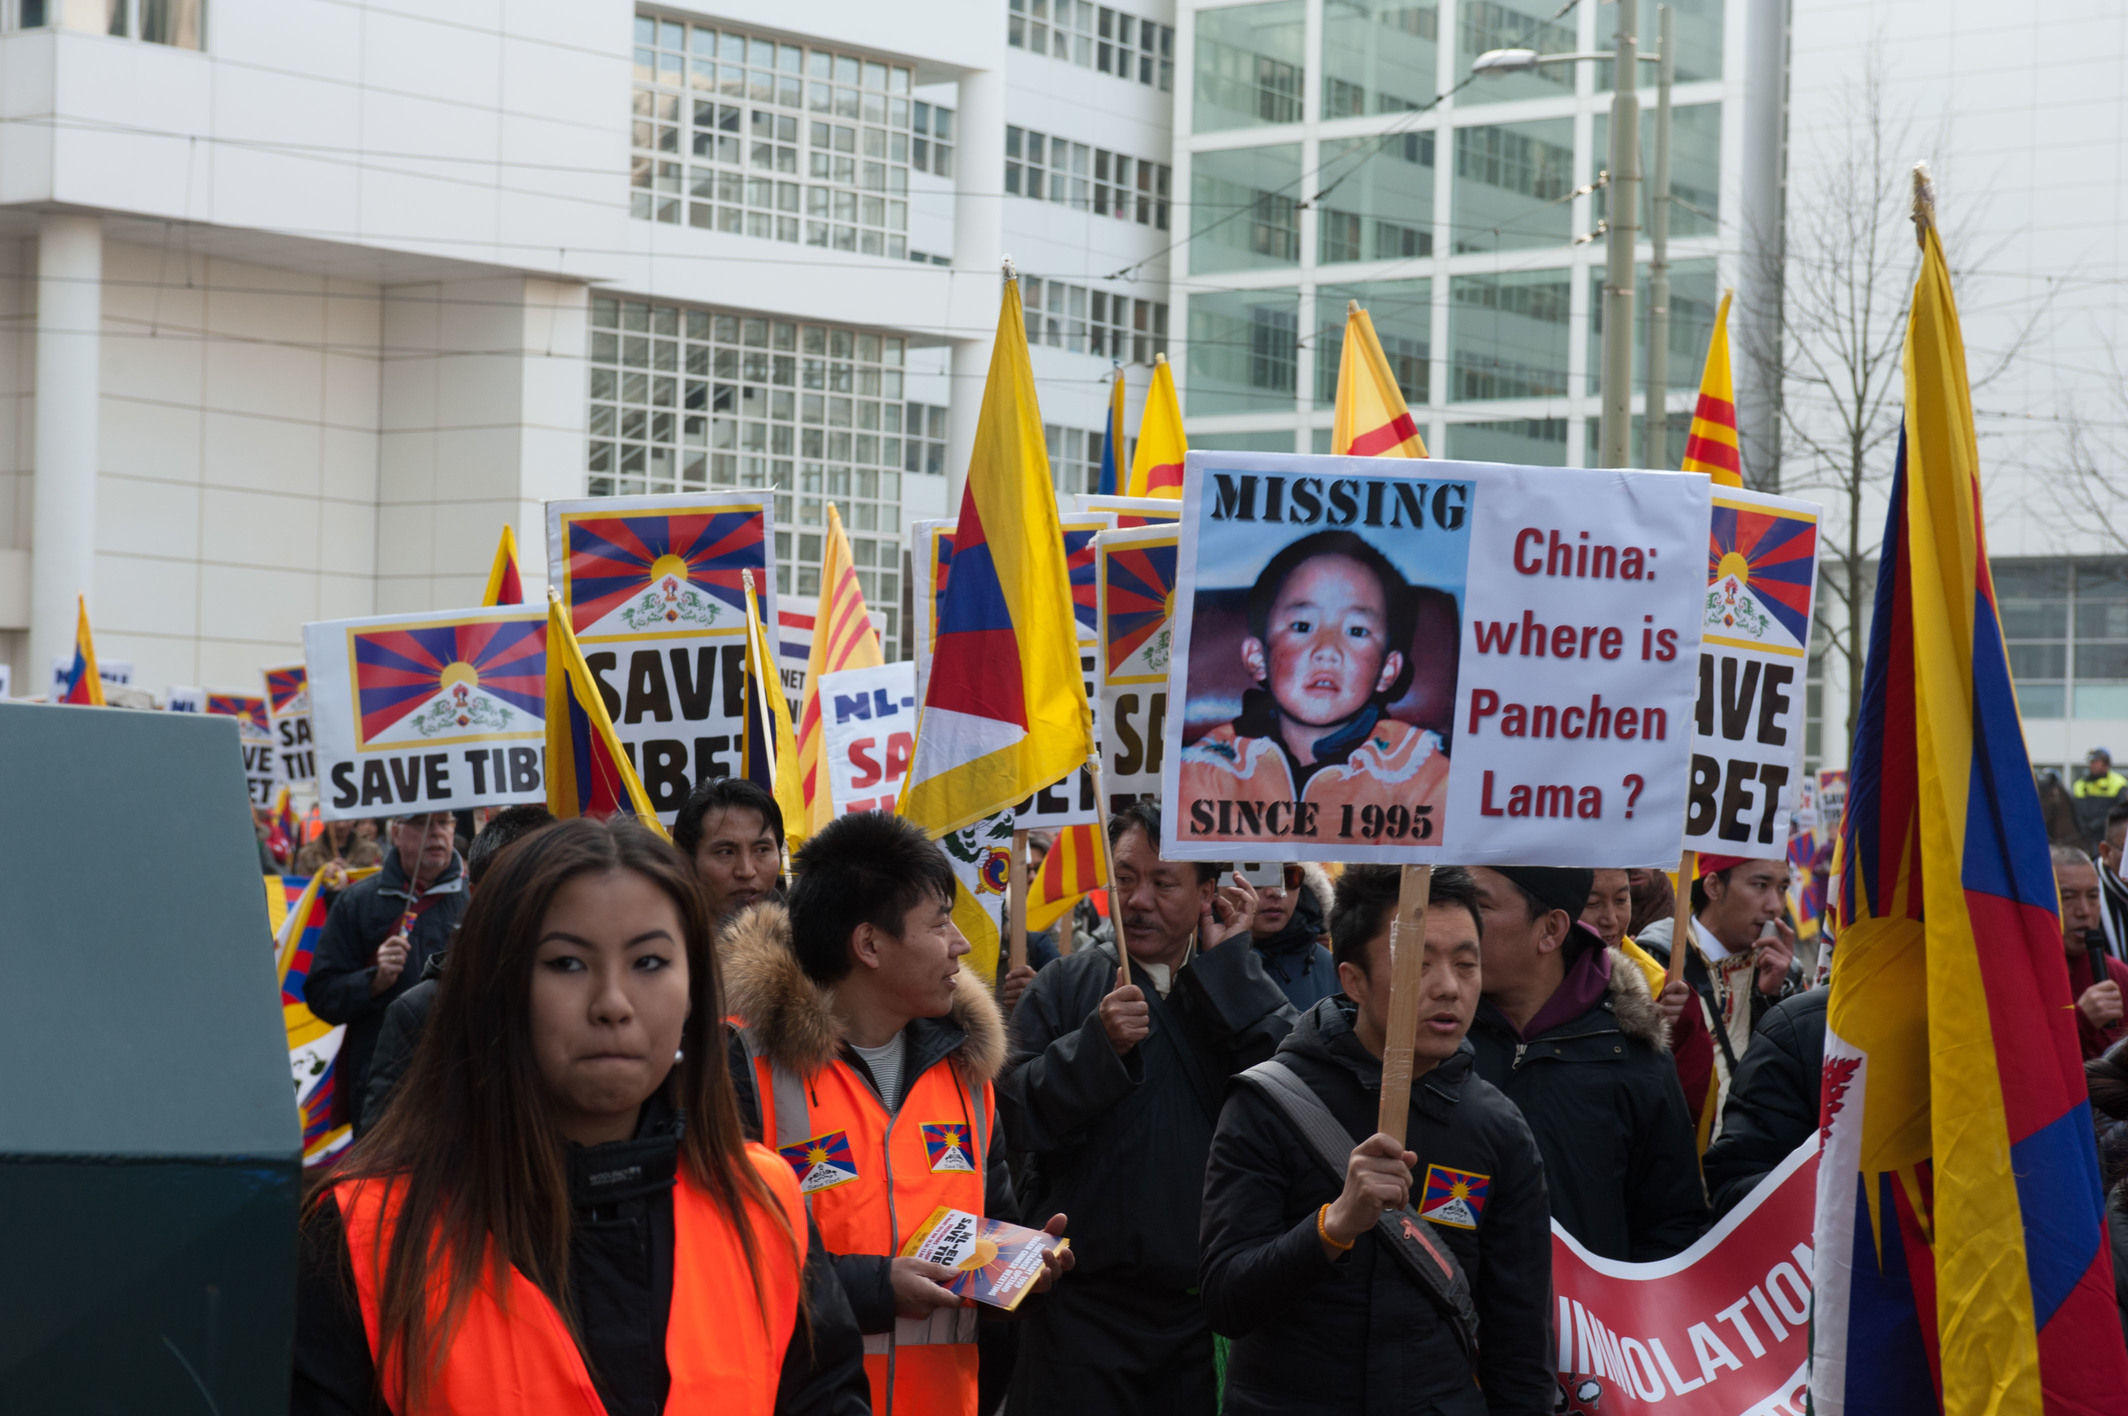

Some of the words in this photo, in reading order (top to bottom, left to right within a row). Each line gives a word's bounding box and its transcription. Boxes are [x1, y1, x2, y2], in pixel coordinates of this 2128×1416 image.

[1210, 474, 1467, 530] MISSING
[1514, 527, 1657, 580] China:
[1474, 609, 1623, 660] where
[1641, 615, 1678, 662] is
[585, 645, 746, 725] SAVE
[1695, 653, 1794, 746] AVE
[279, 719, 312, 747] SA
[1468, 688, 1667, 741] Panchen
[331, 753, 452, 809] SAVE
[465, 746, 547, 795] TIB
[848, 732, 914, 789] SA
[1190, 799, 1319, 837] SINCE
[1338, 804, 1433, 840] 1995
[1481, 769, 1602, 819] Lama
[1622, 773, 1644, 819] ?
[1686, 753, 1789, 844] BET
[930, 1245, 949, 1263] TIB
[941, 1231, 973, 1266] NL-EU
[944, 1217, 972, 1242] SAVE
[1558, 1242, 1814, 1403] IMMOLATIO
